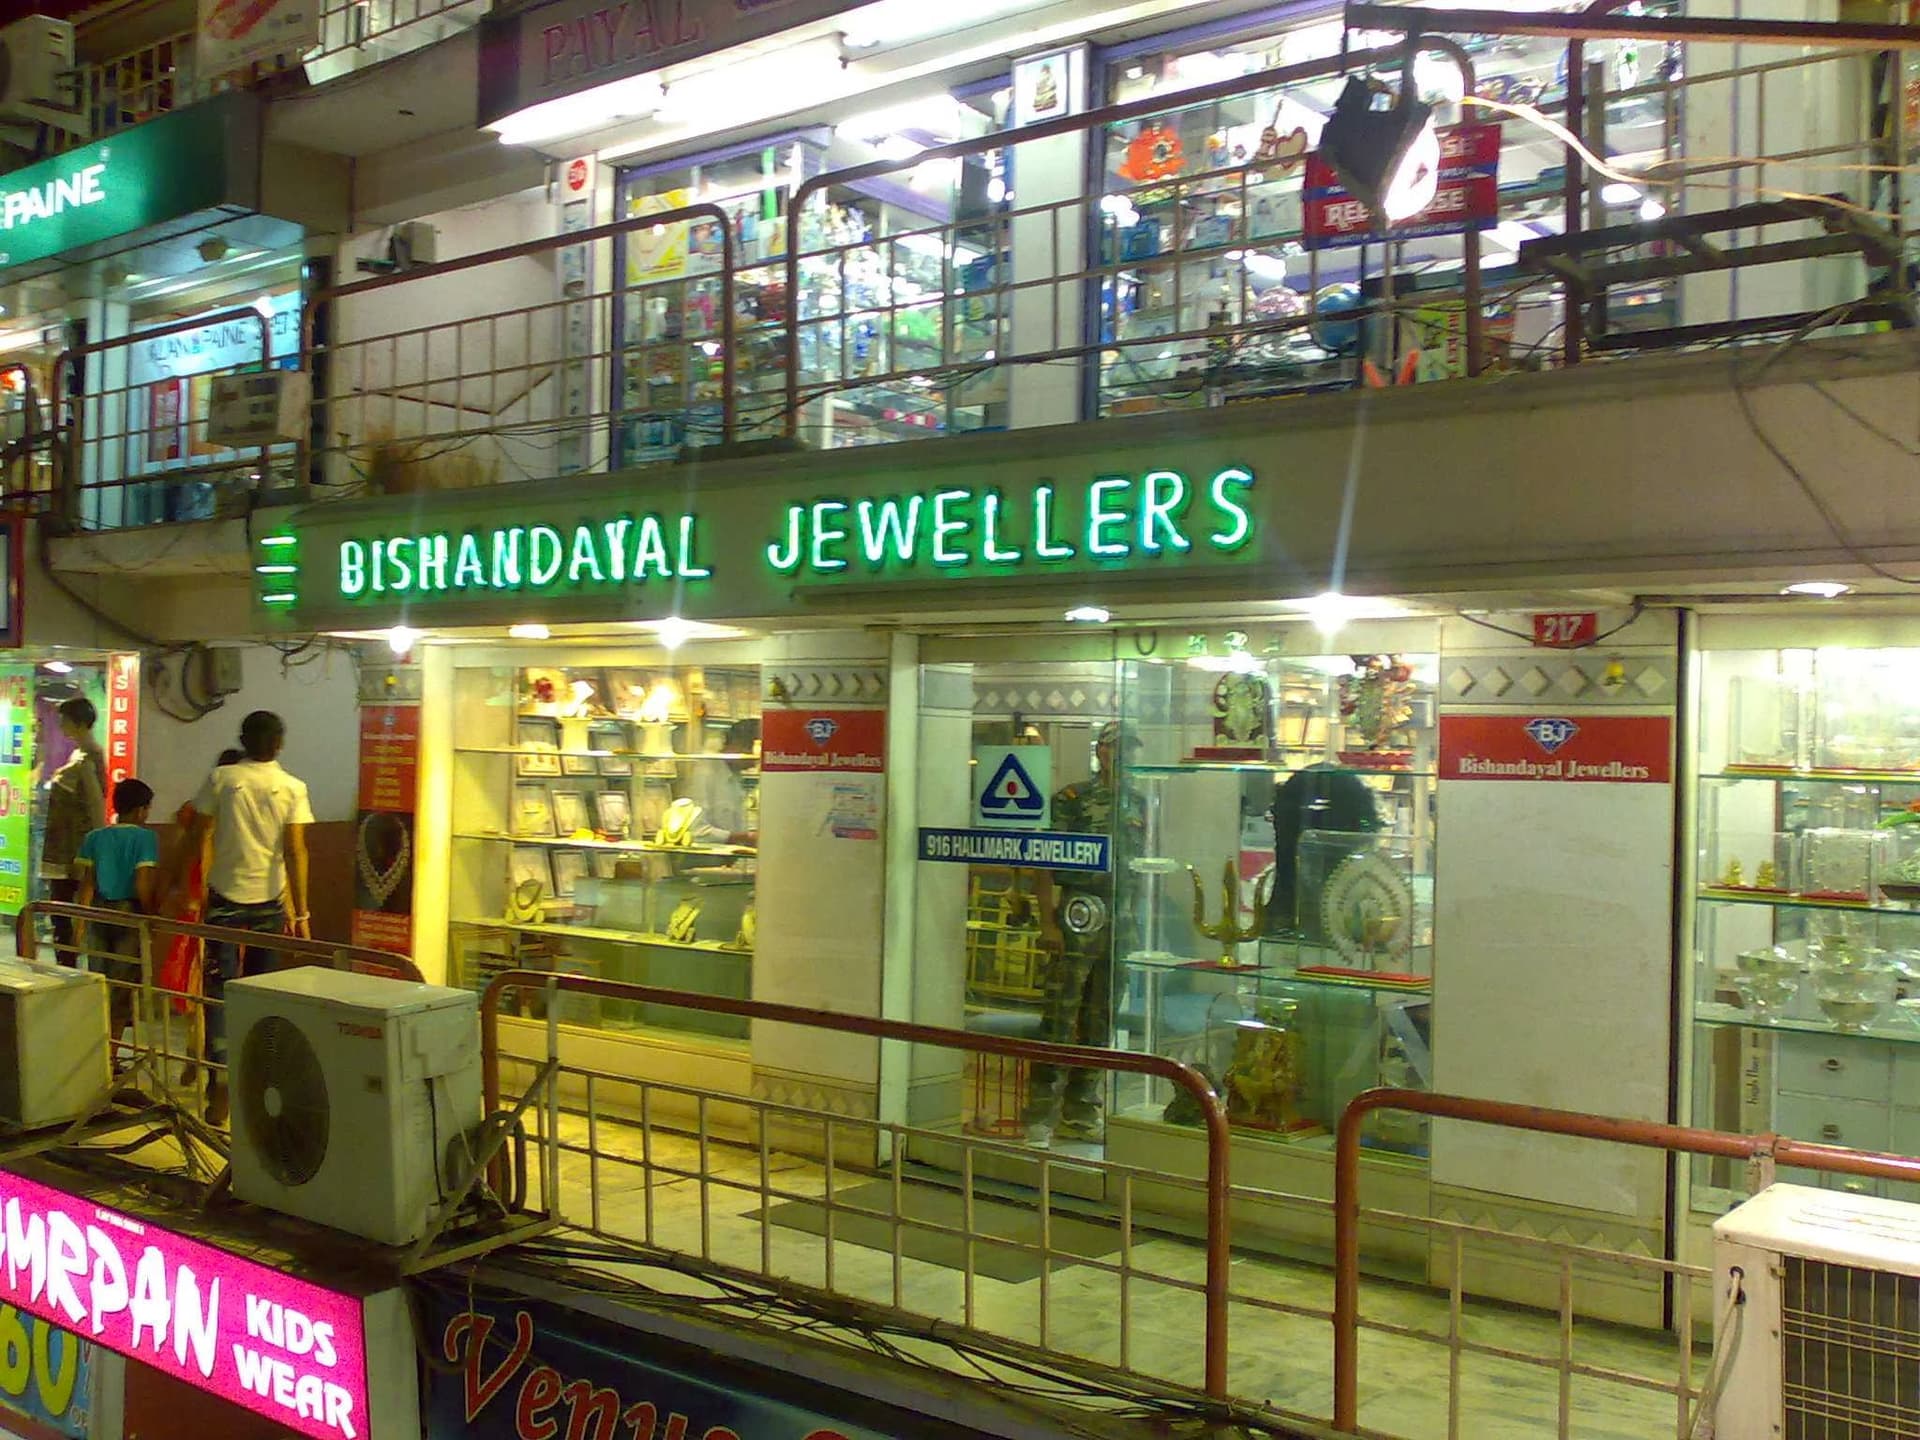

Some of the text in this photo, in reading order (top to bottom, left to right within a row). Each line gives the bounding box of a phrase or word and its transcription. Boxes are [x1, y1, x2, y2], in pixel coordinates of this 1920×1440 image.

[340, 468, 1254, 594] BISHANDAYAL JEWELLERS
[1543, 616, 1583, 642] 217
[1540, 725, 1566, 742] BJ
[1458, 757, 1650, 779] Bishandayal Jewellers
[927, 835, 1103, 865] 916 HALLMARK JEWELLERY
[0, 1196, 221, 1379] MRPAN
[246, 1293, 338, 1368] KIDS
[232, 1343, 357, 1440] WEAR
